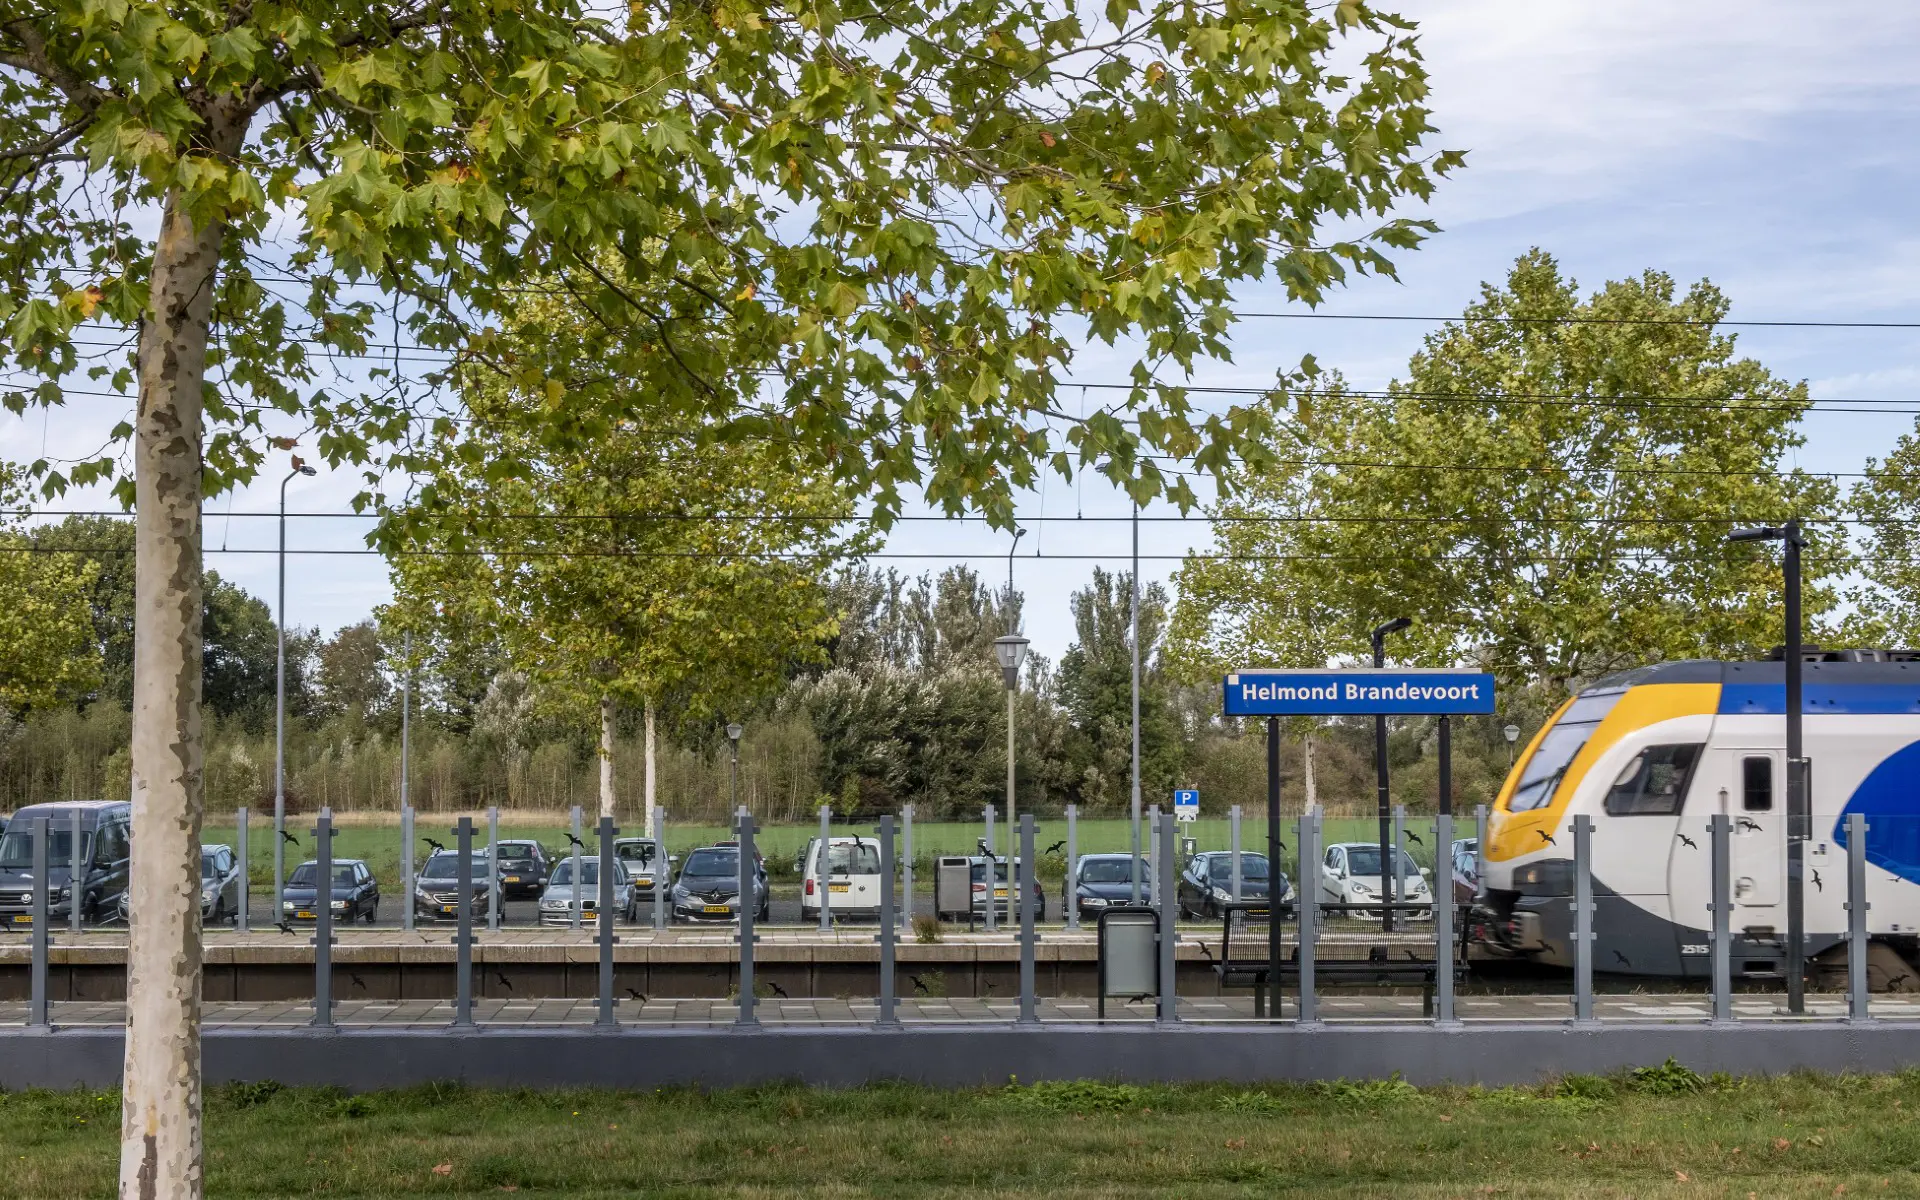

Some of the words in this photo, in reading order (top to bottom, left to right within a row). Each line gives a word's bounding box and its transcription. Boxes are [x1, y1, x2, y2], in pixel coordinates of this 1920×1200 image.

[1242, 682, 1338, 701] Helmond
[1345, 683, 1480, 701] Brandevoort
[1182, 792, 1192, 805] P
